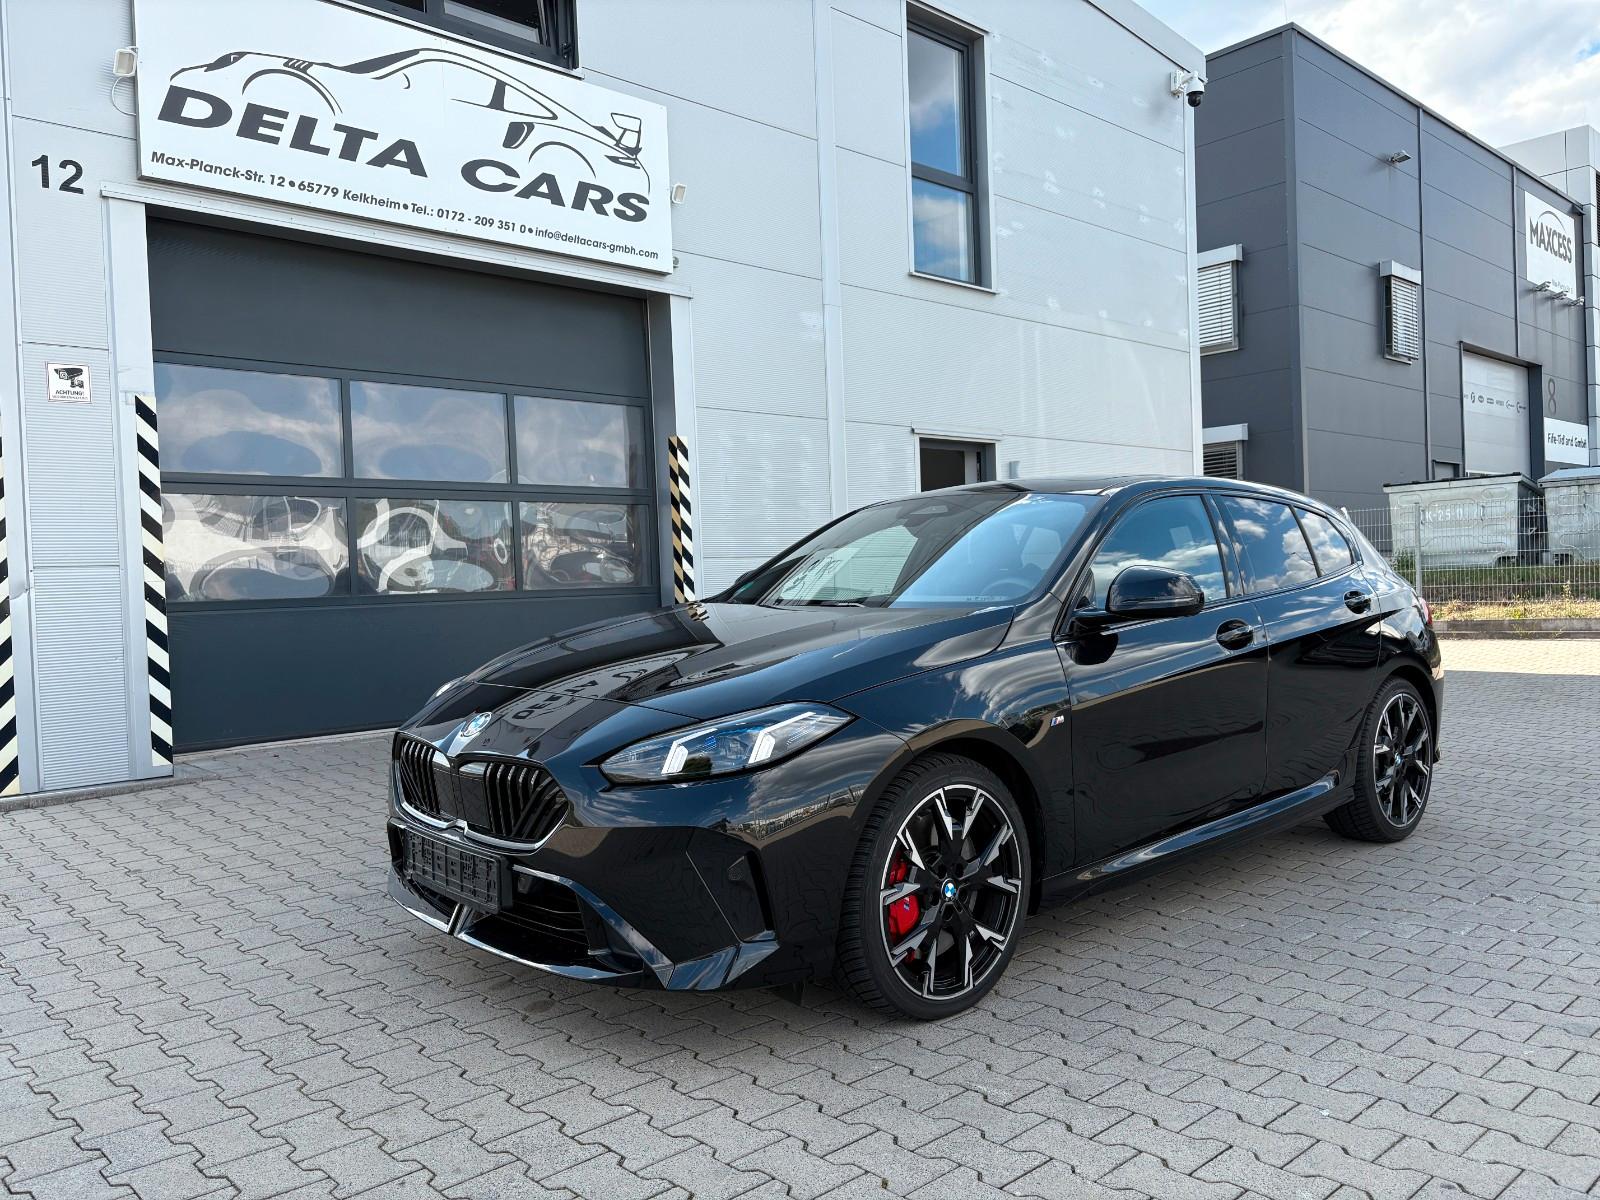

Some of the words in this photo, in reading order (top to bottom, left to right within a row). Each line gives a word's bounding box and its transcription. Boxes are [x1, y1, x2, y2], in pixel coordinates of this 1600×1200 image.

[31, 154, 84, 195] 12
[158, 84, 428, 178] DELTA
[460, 158, 650, 223] CARS
[151, 151, 267, 184] Max-Planck-Str.
[437, 208, 466, 222] 0172
[474, 215, 495, 228] 209
[497, 219, 516, 232] 351
[535, 226, 659, 260] info@deltacars-gmbh.com
[1529, 217, 1572, 264] MAXCESS
[1547, 378, 1557, 416] 8
